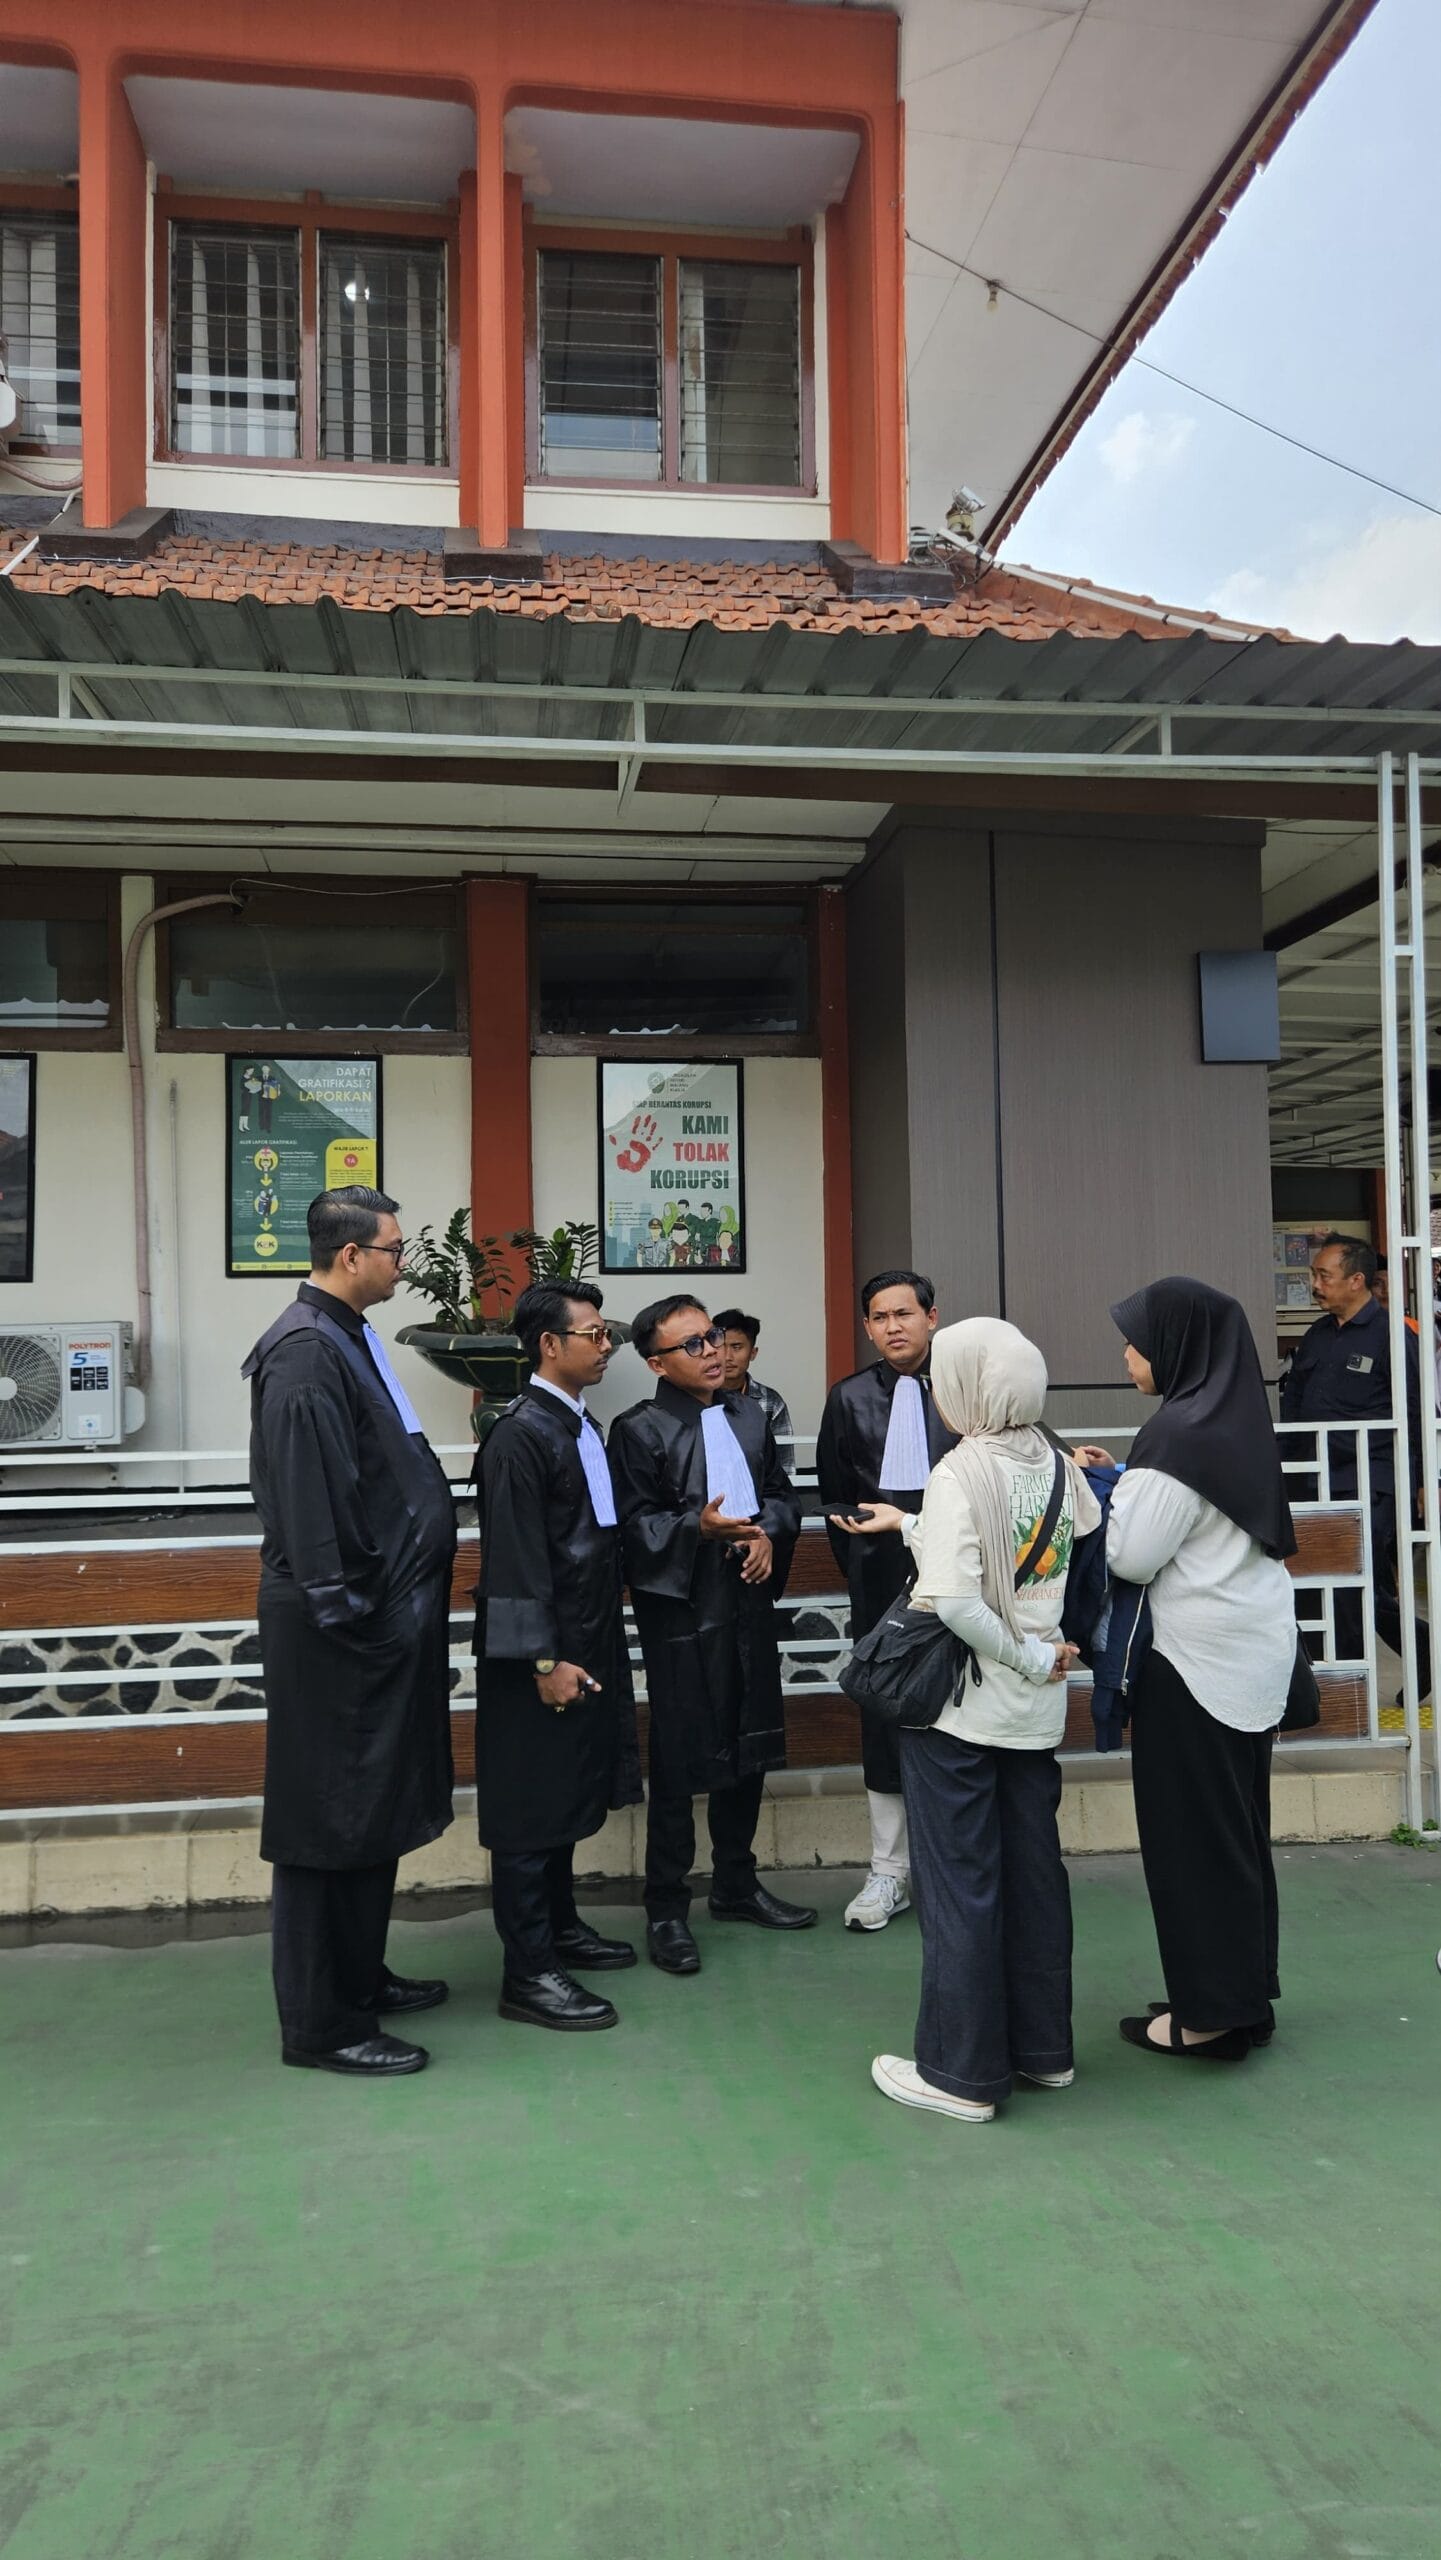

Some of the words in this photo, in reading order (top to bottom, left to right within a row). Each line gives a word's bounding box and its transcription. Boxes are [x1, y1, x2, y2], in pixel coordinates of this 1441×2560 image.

[337, 1067, 371, 1077] DAPAT
[298, 1079, 362, 1089] GRATIFIKASI
[299, 1091, 372, 1102] LAPORKAN
[648, 1101, 682, 1109] BERANTAS
[683, 1101, 712, 1109] KORUPSI
[682, 1115, 729, 1135] KAMI
[673, 1142, 730, 1162] TOLAK
[650, 1169, 729, 1189] KORUPSI
[68, 1342, 112, 1350] POLYTRON
[72, 1352, 88, 1366] 5
[1012, 1473, 1055, 1494] FARME
